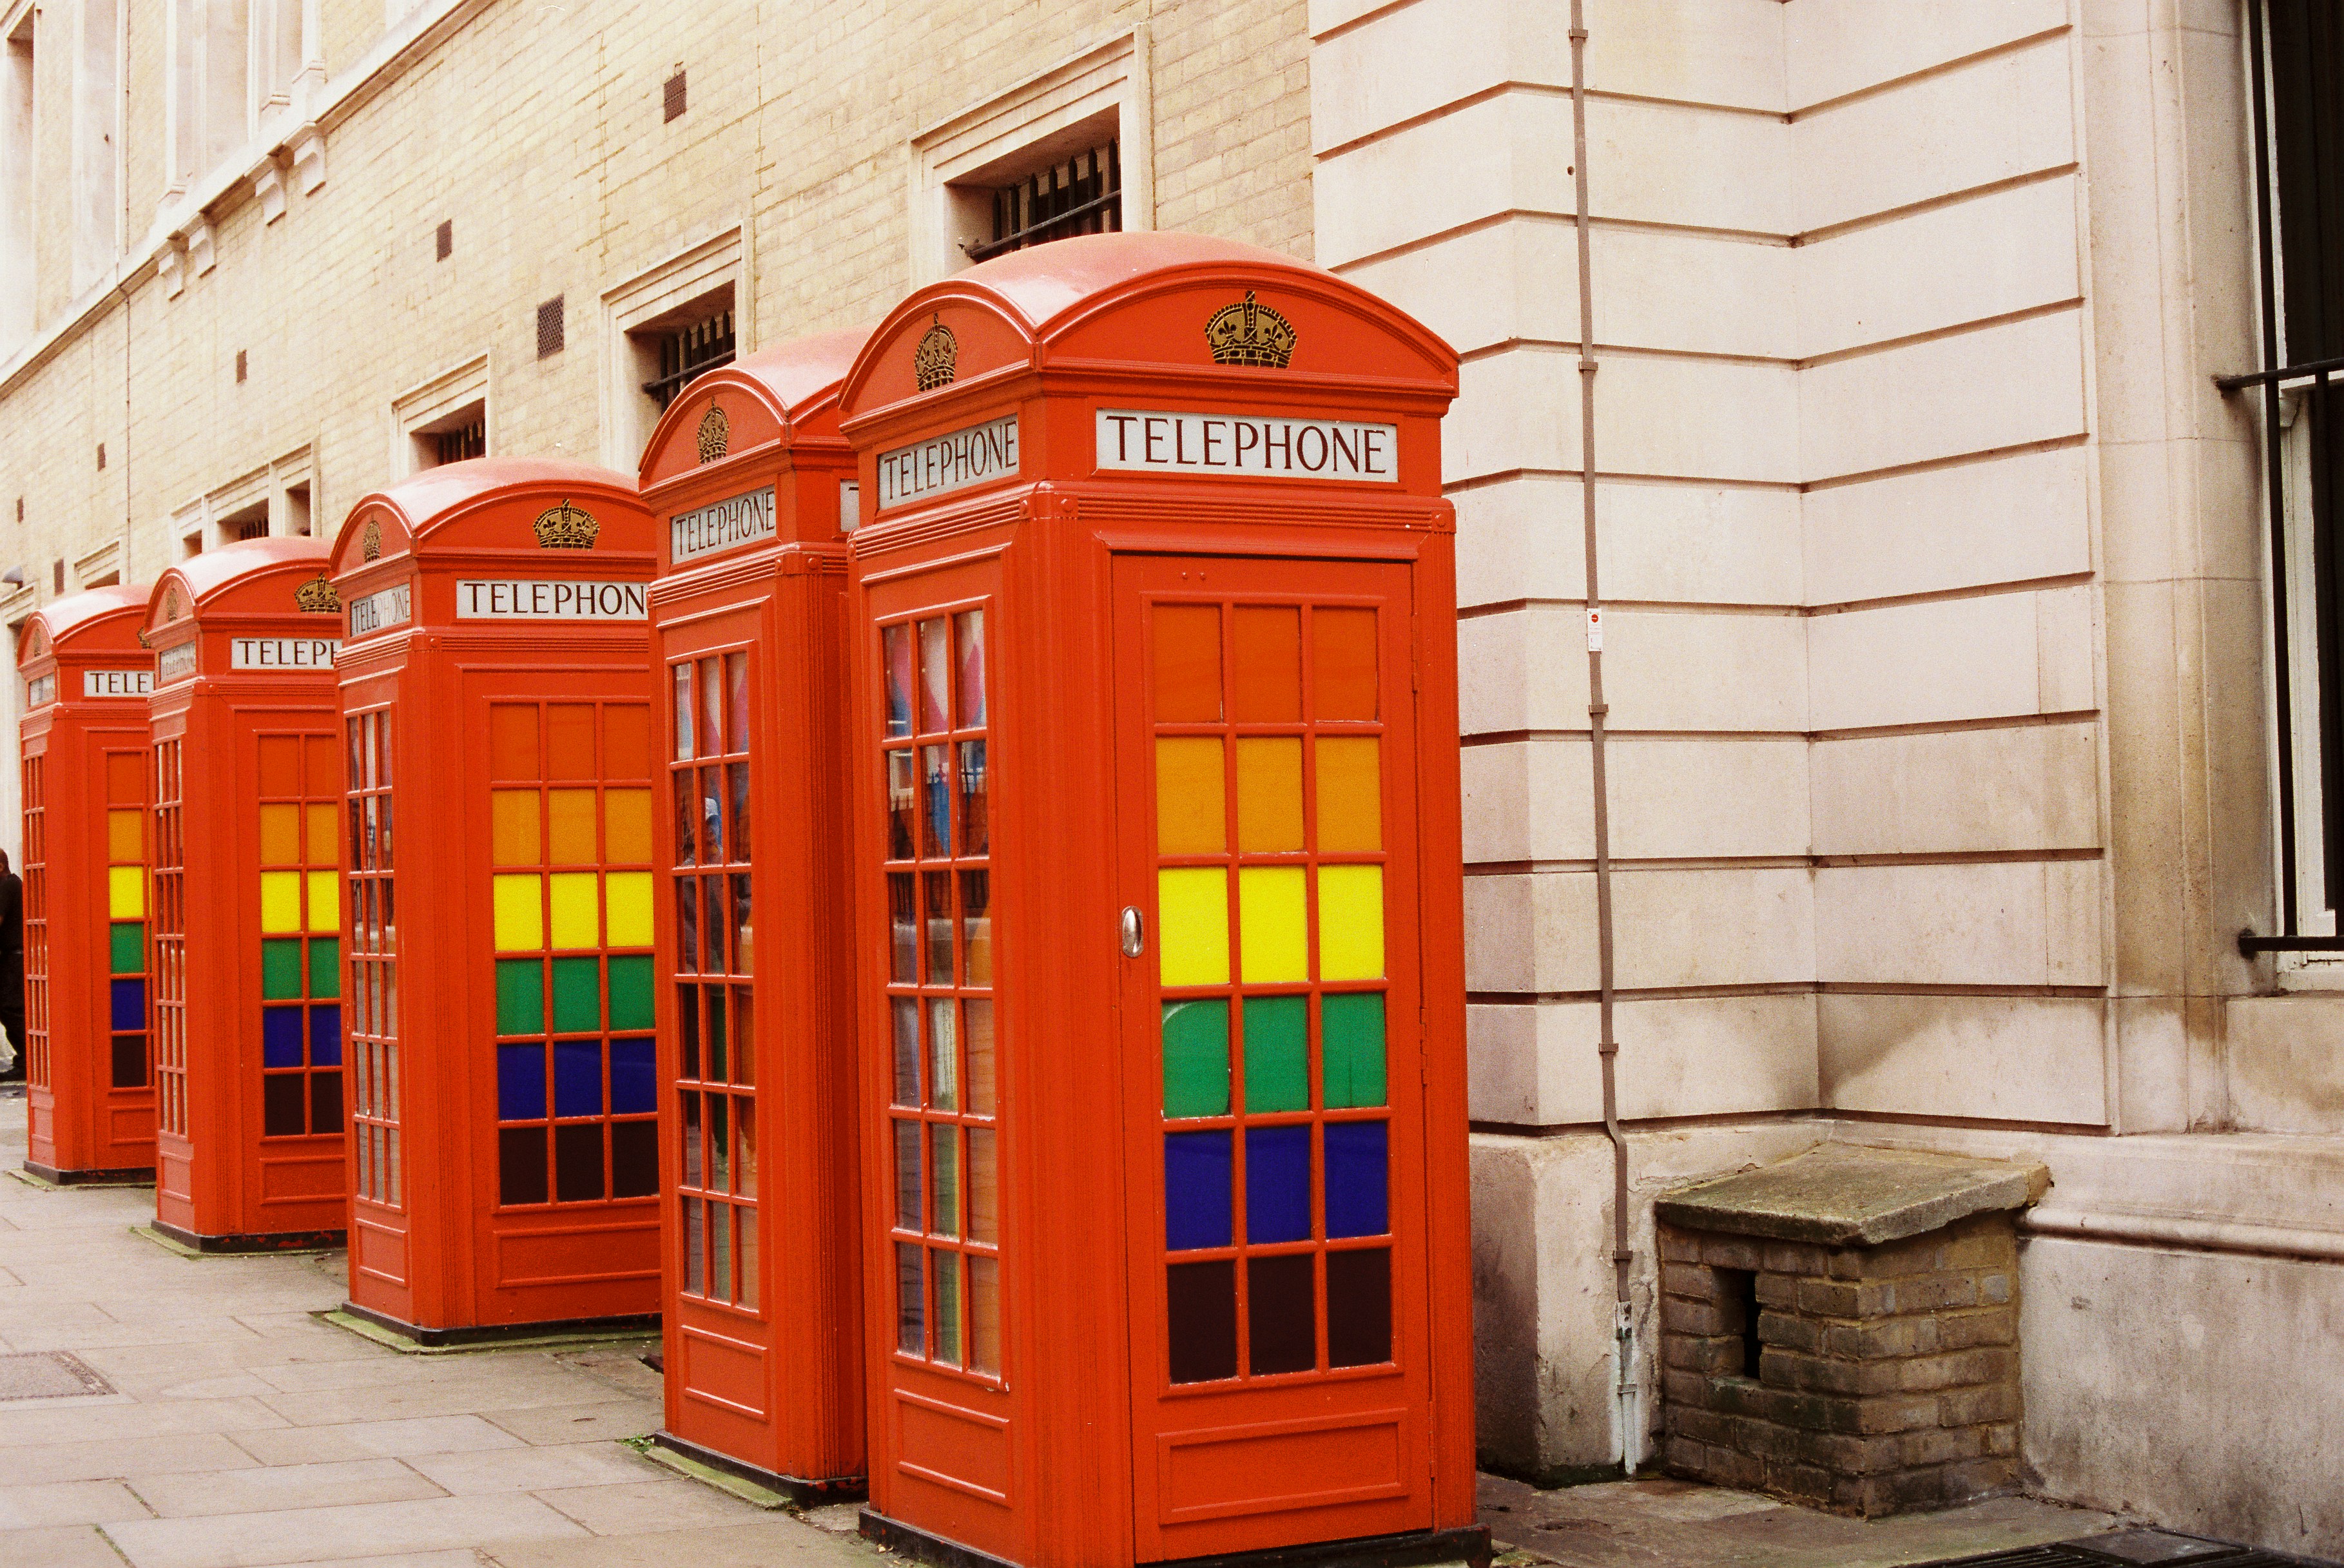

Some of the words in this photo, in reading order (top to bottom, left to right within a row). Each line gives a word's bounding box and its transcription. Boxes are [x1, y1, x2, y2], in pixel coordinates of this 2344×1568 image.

[884, 421, 1017, 499] TELEPHONE
[1106, 416, 1386, 474] TELEPHONE
[676, 490, 775, 556] TELEPHONE
[90, 673, 155, 693] TELE
